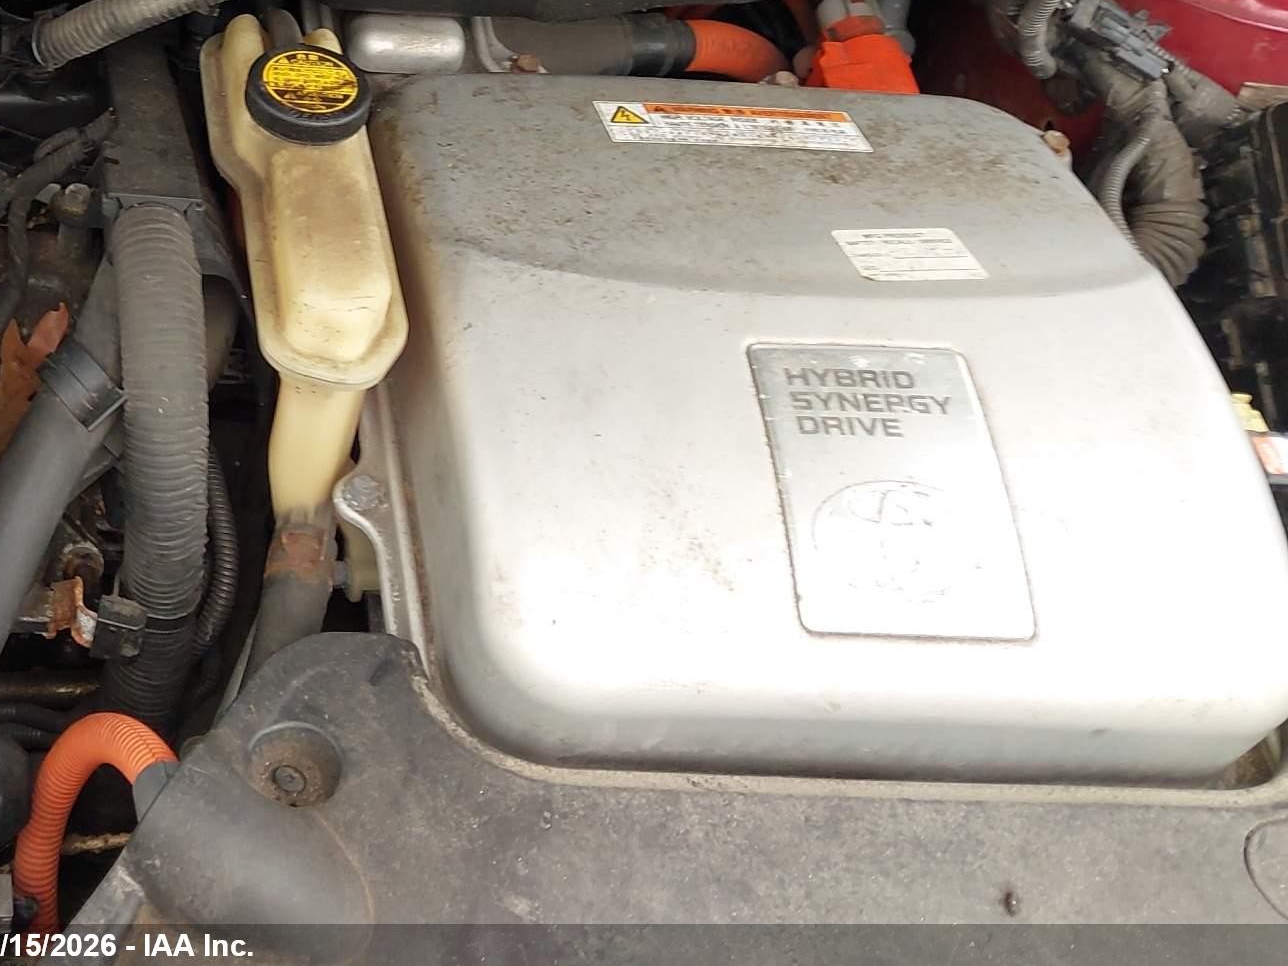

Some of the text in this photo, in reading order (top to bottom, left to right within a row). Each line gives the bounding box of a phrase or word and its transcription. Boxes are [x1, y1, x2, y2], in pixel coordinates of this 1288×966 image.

[784, 367, 915, 389] HYBRID
[790, 391, 952, 414] SYNERGY
[796, 415, 905, 437] DRIVE
